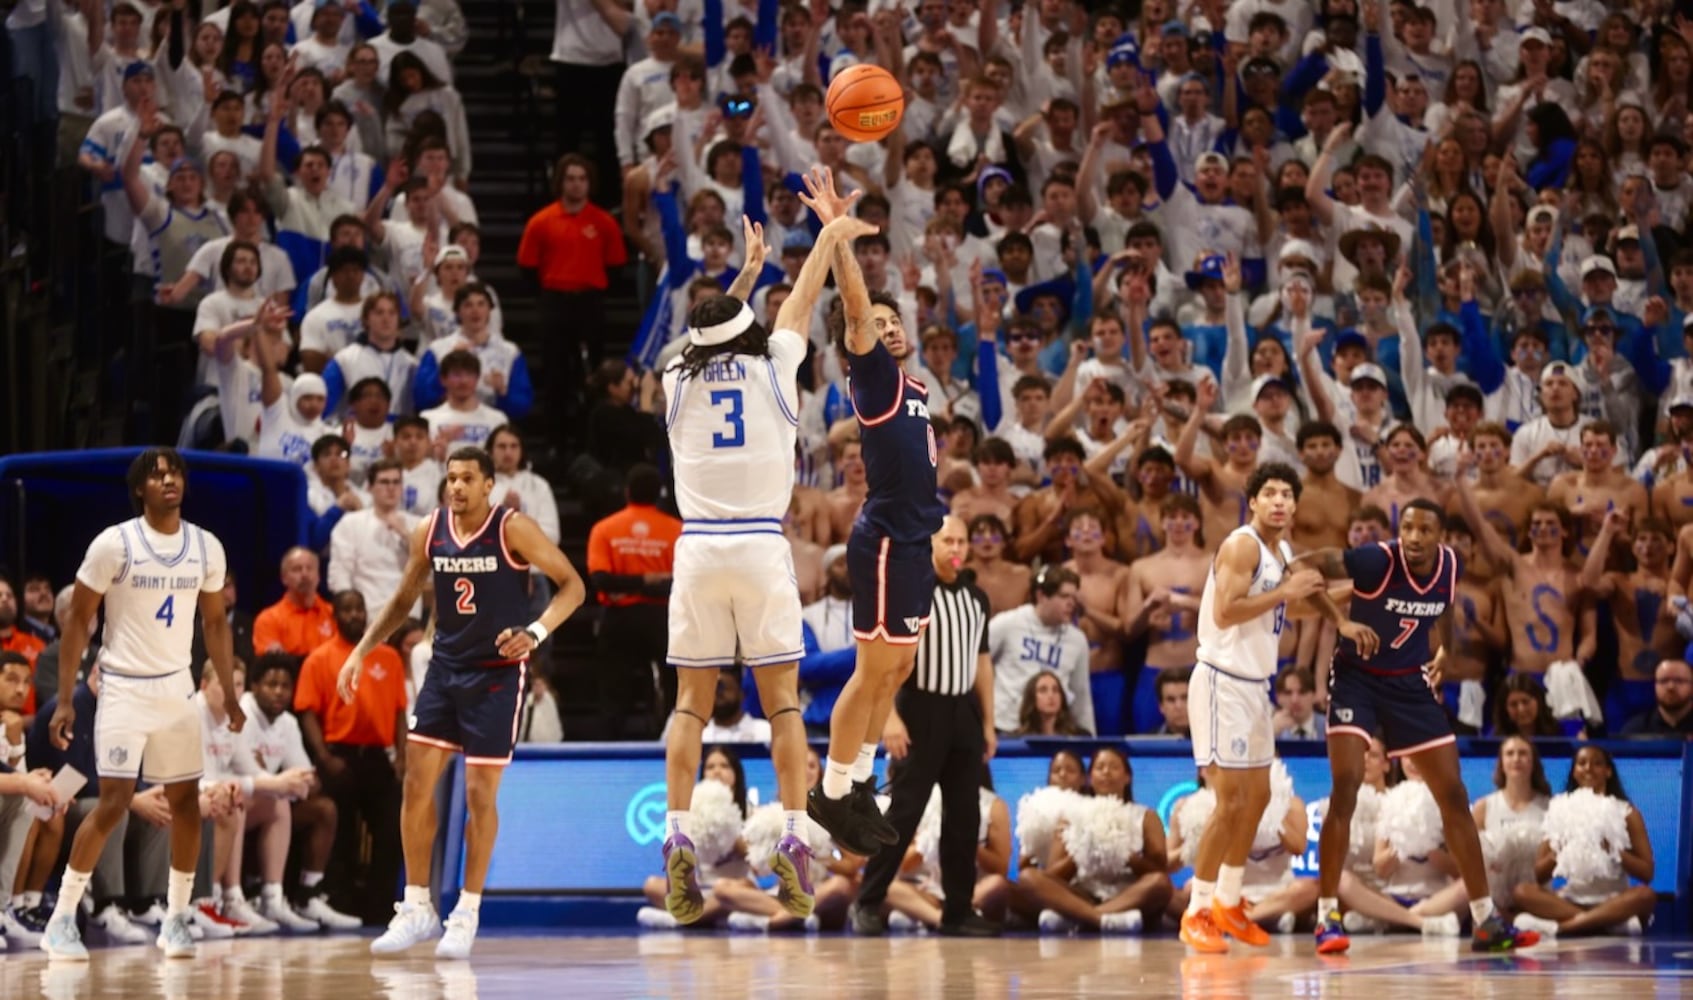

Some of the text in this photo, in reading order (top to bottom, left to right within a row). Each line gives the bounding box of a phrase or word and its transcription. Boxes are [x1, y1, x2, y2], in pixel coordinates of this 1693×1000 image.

[703, 362, 746, 383] GREEN
[710, 389, 745, 448] 3
[433, 556, 498, 573] FLYERS
[132, 576, 200, 590] SAINT LOUIS
[454, 577, 477, 614] 2
[155, 594, 174, 628] 4
[1384, 598, 1445, 617] FLYERS
[1524, 584, 1563, 654] S
[1390, 618, 1419, 650] 7
[1020, 637, 1062, 670] SLU
